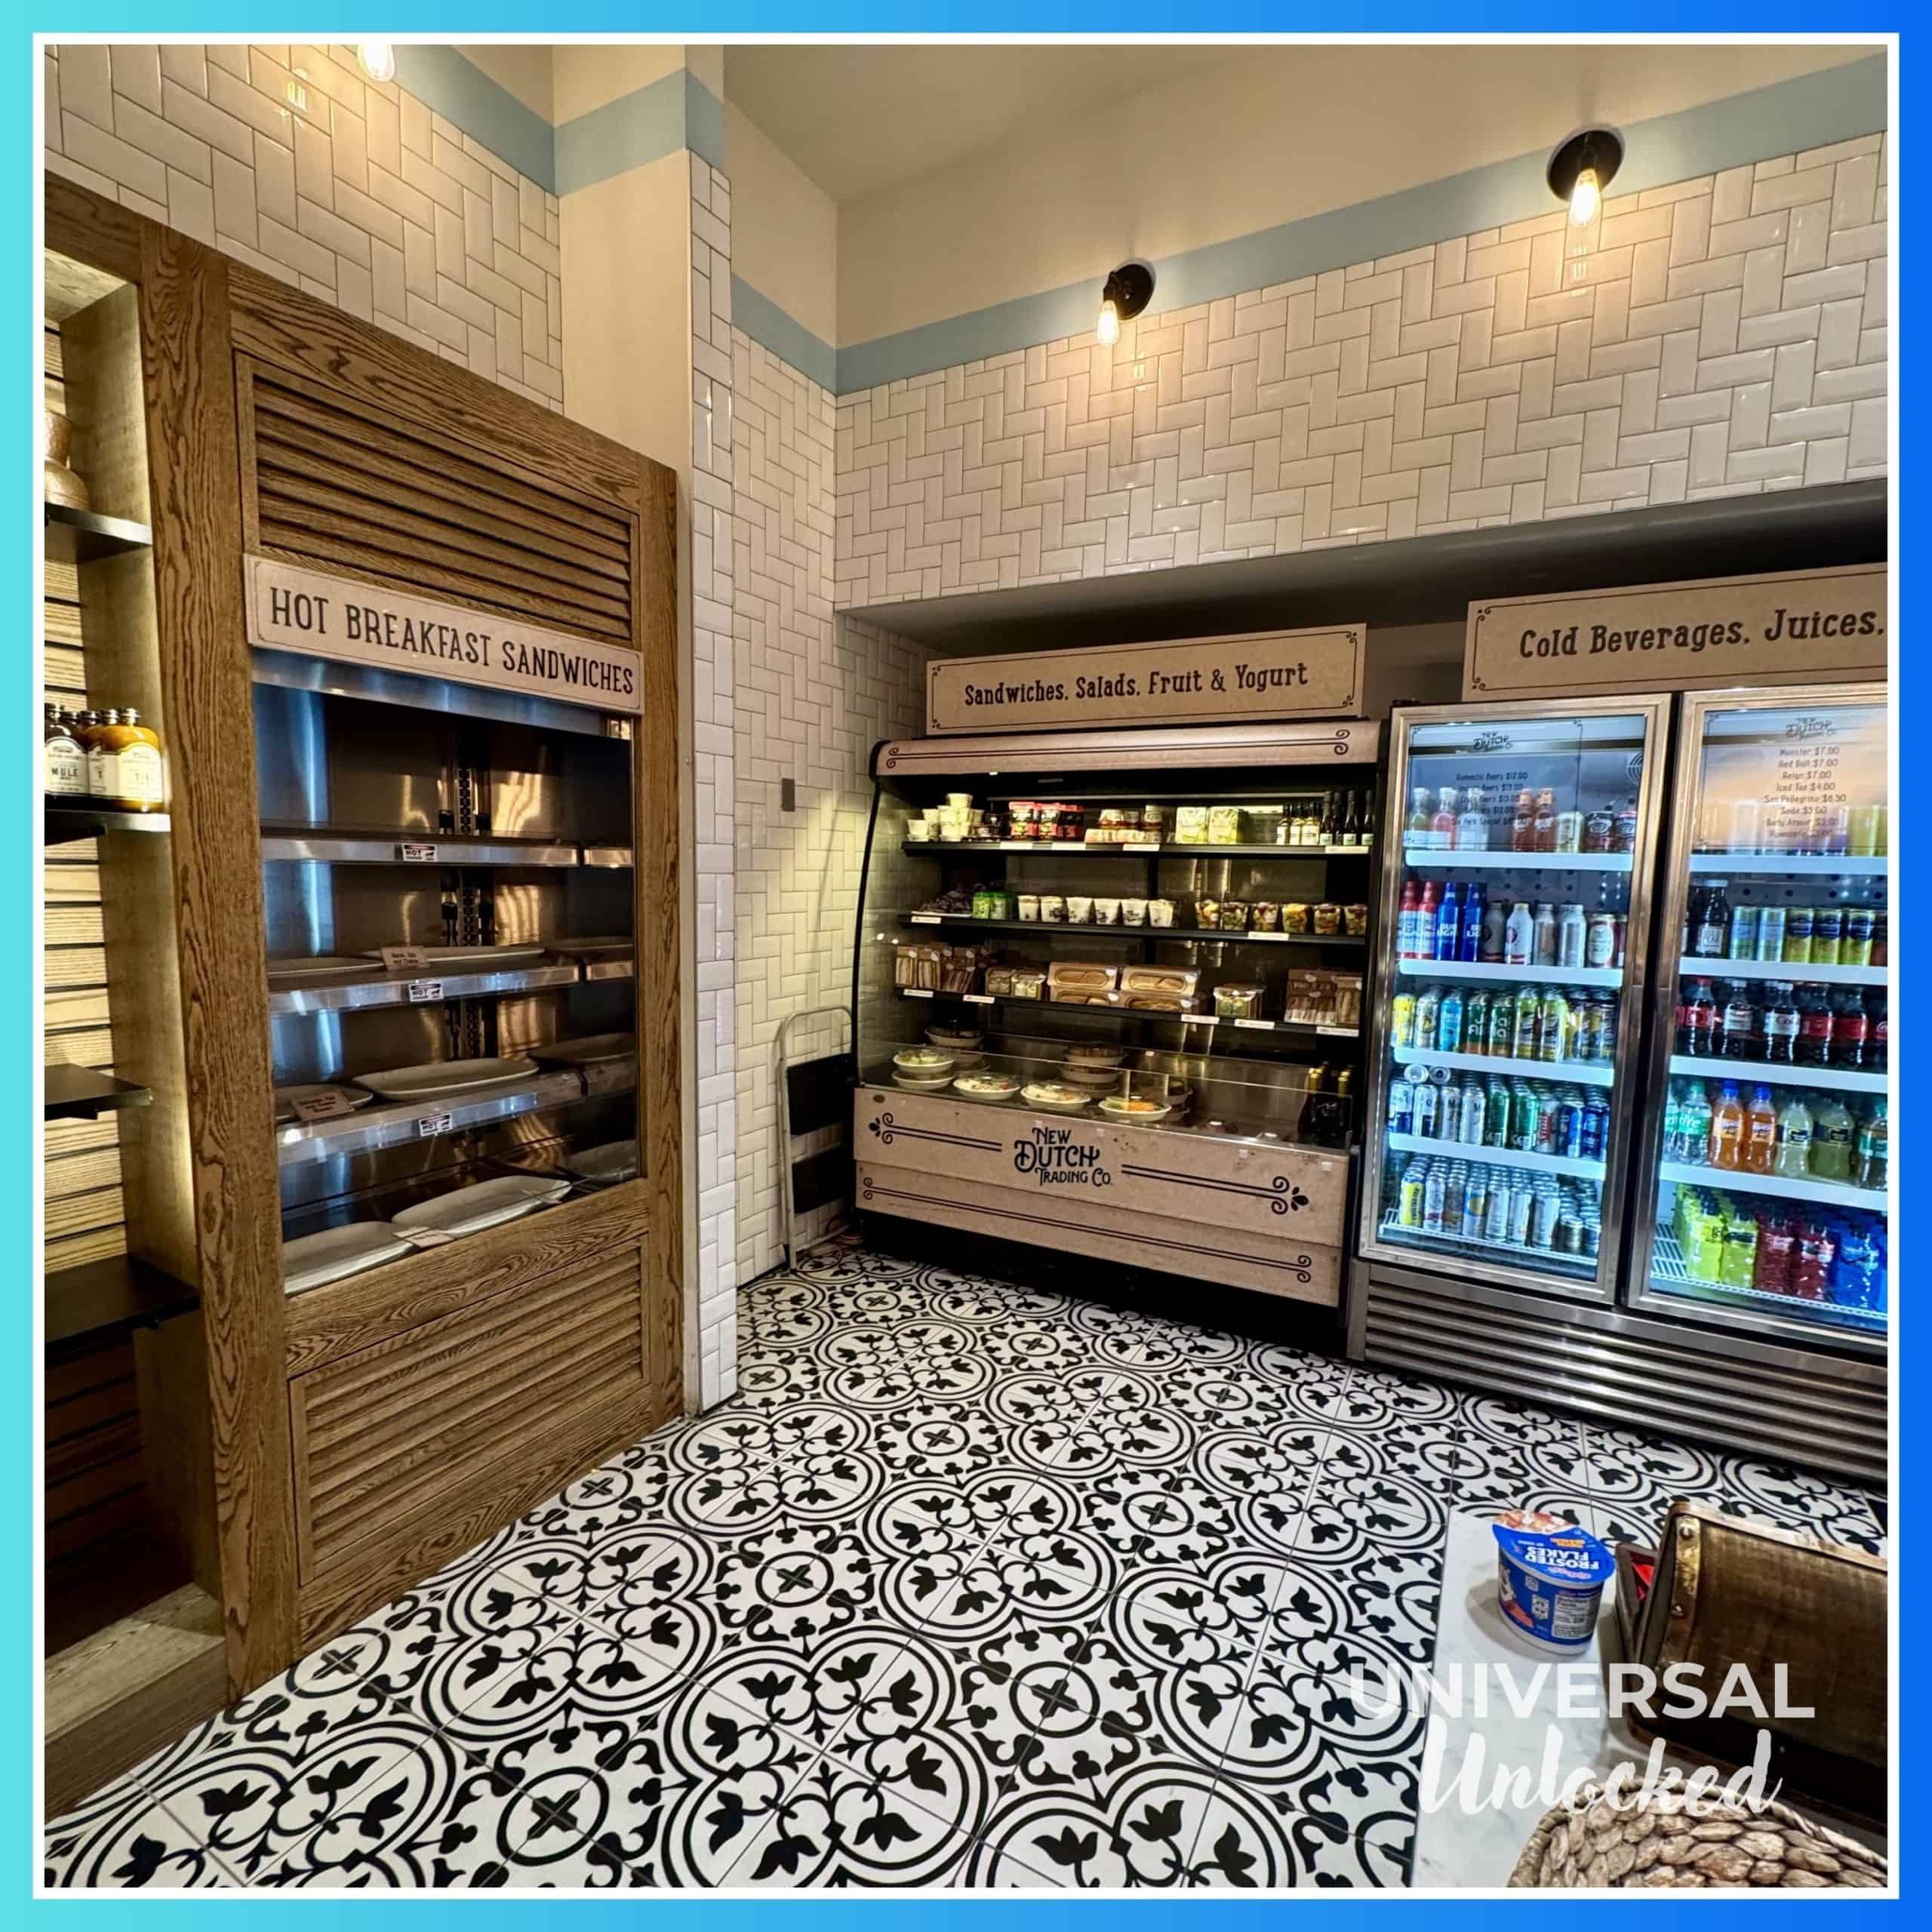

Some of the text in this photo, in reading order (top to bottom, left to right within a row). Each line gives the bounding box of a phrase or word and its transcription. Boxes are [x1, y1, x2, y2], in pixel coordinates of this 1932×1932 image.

[270, 586, 634, 695] HOT BREAKFAST SANDWICHES
[1519, 626, 1578, 659] Cold
[1148, 670, 1203, 694] Fruit
[1211, 669, 1226, 692] &
[1235, 663, 1308, 692] Yogurt
[51, 767, 79, 777] MULE
[1032, 1126, 1072, 1144] NEW
[1014, 1140, 1100, 1173] DUTCH
[1034, 1167, 1088, 1186] TRADING
[1524, 1554, 1600, 1570] FROSTED
[1527, 1546, 1589, 1561] FLAKES
